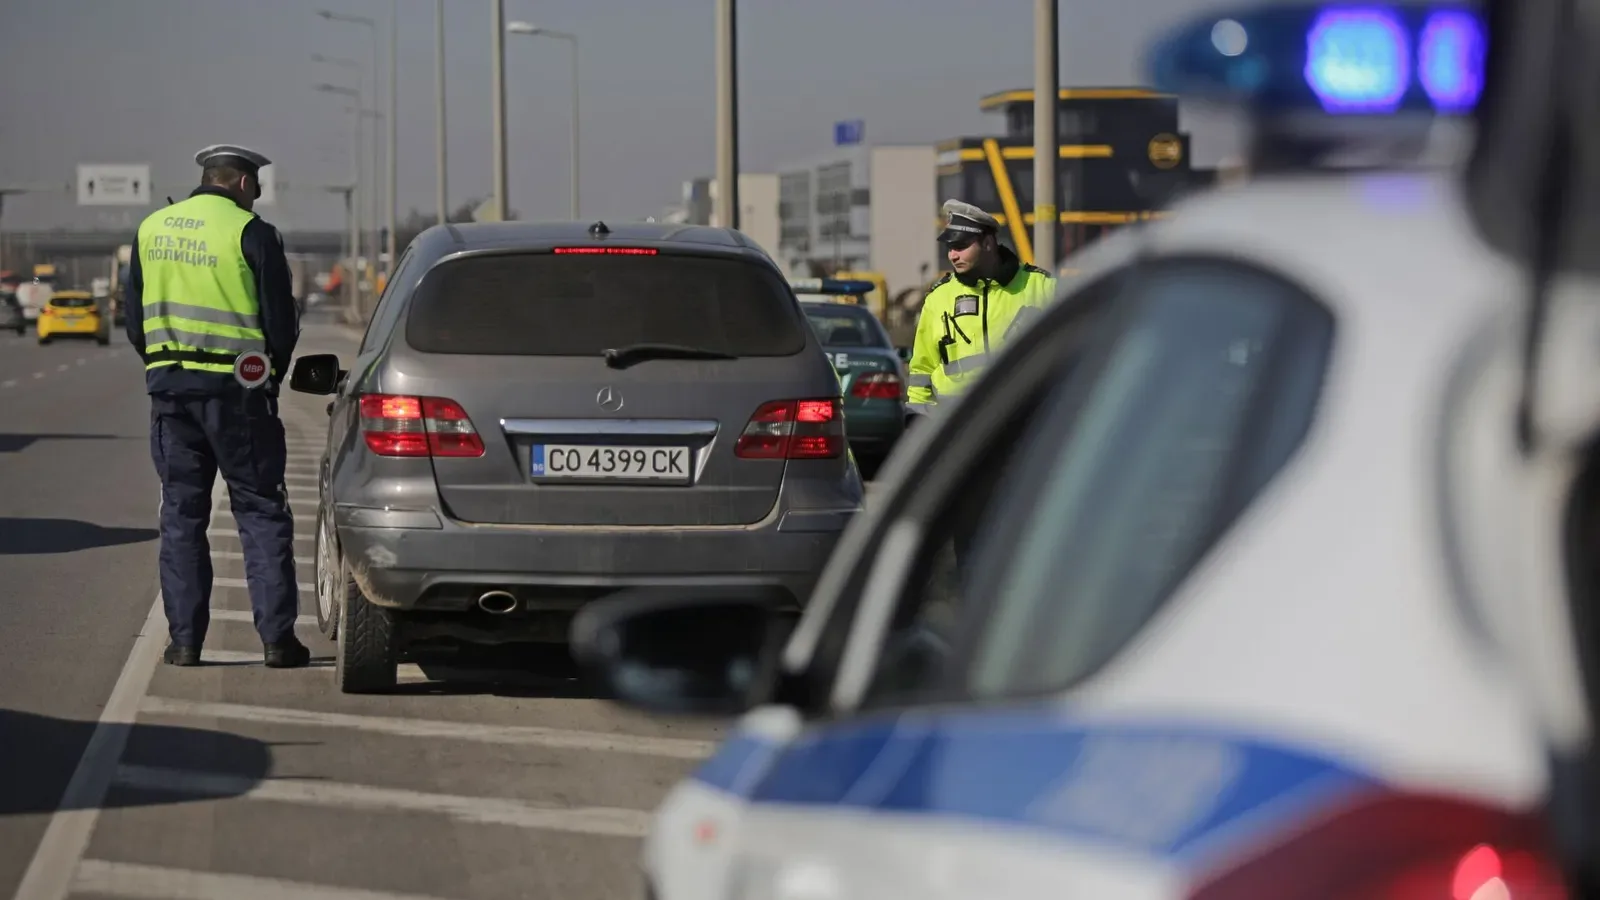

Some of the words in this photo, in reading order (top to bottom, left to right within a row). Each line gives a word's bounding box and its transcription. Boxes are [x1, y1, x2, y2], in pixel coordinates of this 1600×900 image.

[164, 216, 205, 230] СДВР
[154, 235, 208, 253] ПЪТНА
[148, 248, 219, 268] ПОЛИЦИЯ
[243, 363, 263, 373] МВР
[549, 448, 581, 472] CO
[587, 449, 647, 473] 4399
[652, 450, 684, 474] CK
